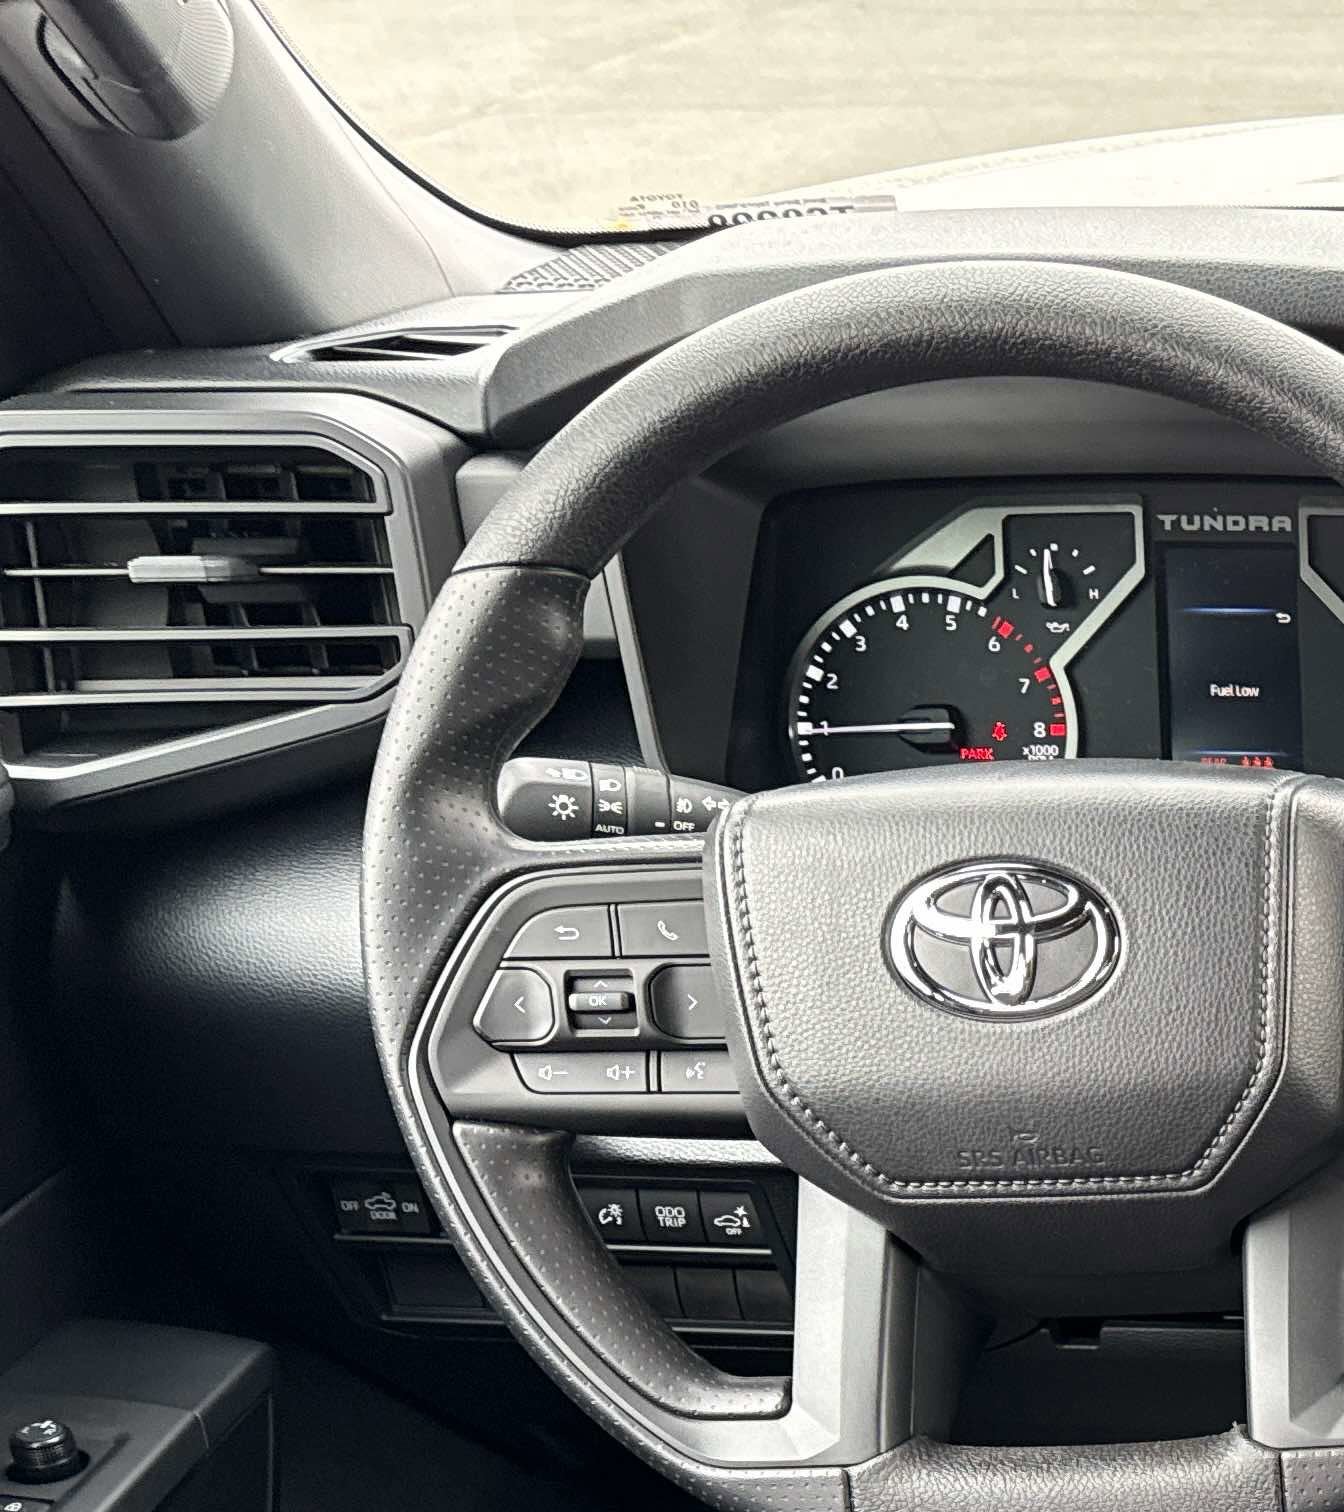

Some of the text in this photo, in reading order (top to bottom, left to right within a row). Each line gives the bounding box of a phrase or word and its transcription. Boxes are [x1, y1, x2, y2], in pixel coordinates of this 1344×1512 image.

[1157, 514, 1292, 532] TUNDRA
[1012, 588, 1019, 598] L
[1089, 589, 1098, 599] H
[896, 615, 909, 630] 4
[946, 615, 957, 631] 5
[856, 636, 867, 651] 3
[988, 637, 1000, 652] 6
[827, 674, 838, 689] 2
[1019, 679, 1030, 694] 7
[1210, 684, 1233, 697] Fuel
[820, 721, 829, 736] 1
[1033, 722, 1046, 738] 8
[960, 748, 994, 760] PARK
[1022, 745, 1059, 756] x1000
[832, 767, 844, 781] 0
[595, 824, 624, 835] AUTO
[673, 821, 695, 831] OFF
[589, 995, 608, 1006] OK
[655, 1206, 686, 1217] ODO
[658, 1217, 687, 1227] TRIP
